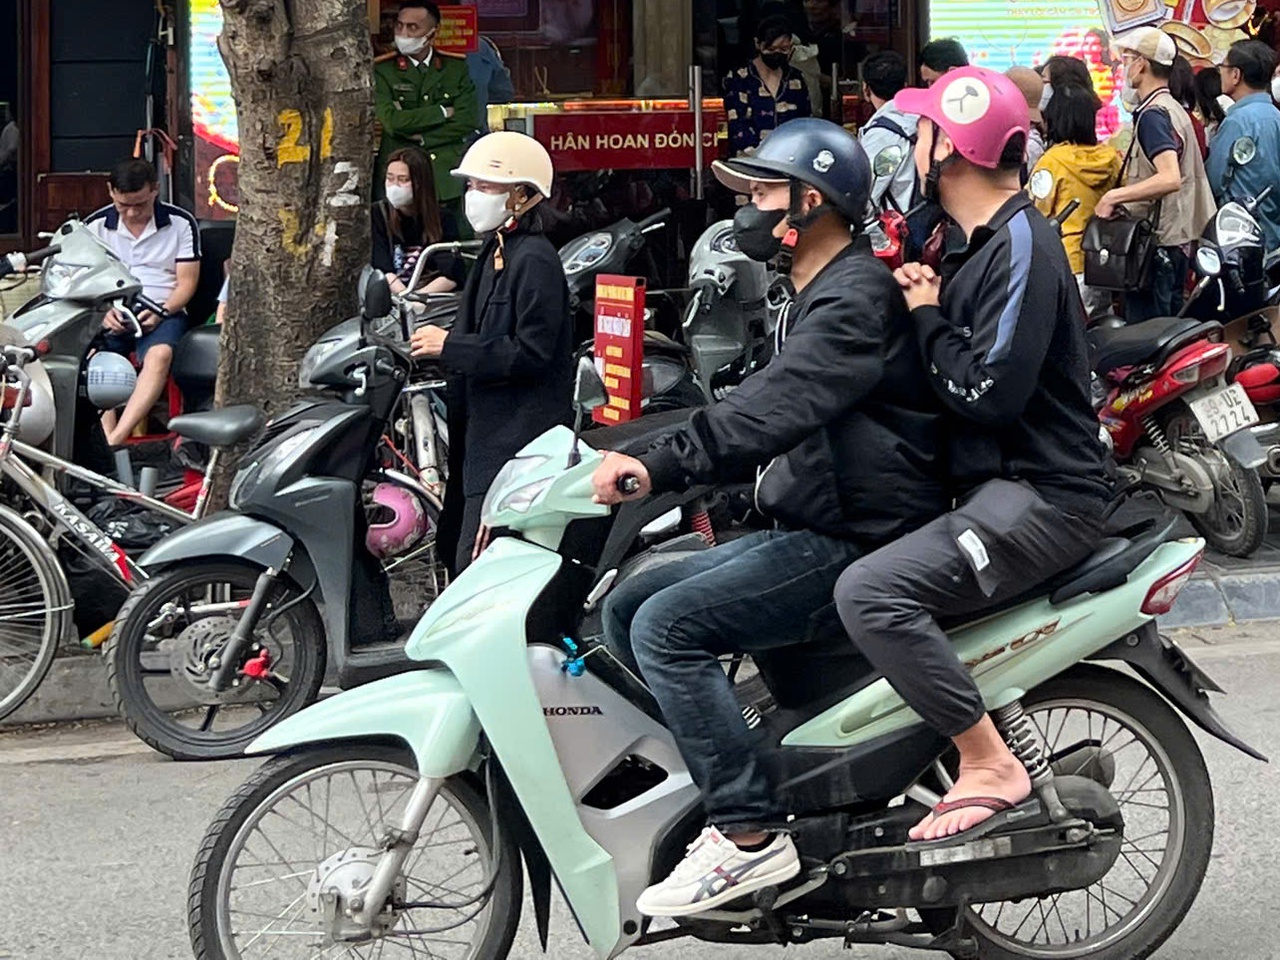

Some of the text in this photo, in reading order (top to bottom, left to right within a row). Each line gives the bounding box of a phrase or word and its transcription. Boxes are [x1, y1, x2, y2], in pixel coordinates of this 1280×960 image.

[551, 132, 590, 151] HÂN
[595, 133, 649, 149] HOAN
[655, 129, 695, 149] ĐÓN
[542, 706, 604, 717] HONDA
